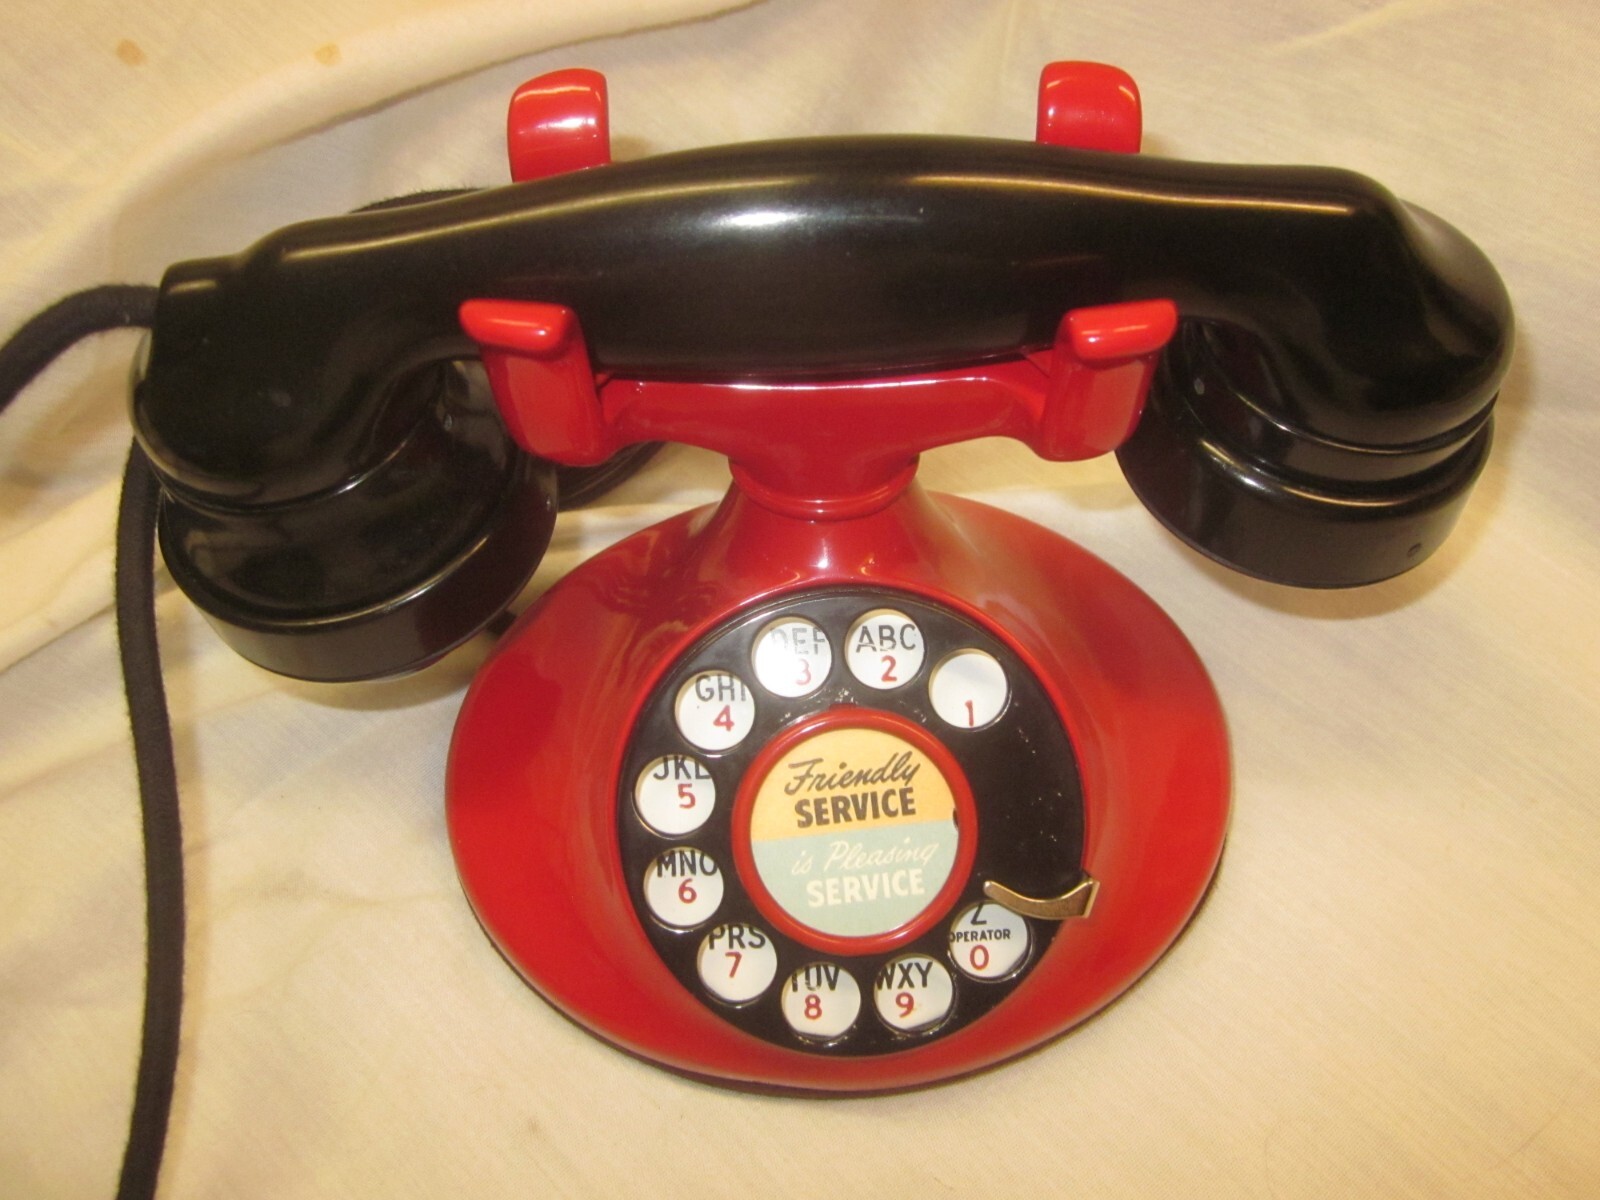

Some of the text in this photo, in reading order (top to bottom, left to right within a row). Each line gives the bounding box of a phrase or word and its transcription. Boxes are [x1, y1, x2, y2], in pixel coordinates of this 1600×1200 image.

[856, 624, 916, 652] ABC
[796, 659, 811, 686] 3
[881, 655, 897, 682] 2
[695, 674, 746, 702] GHI
[713, 705, 734, 732] 4
[965, 700, 974, 726] 1
[653, 756, 712, 780] JKL
[784, 751, 920, 795] Friendly
[678, 783, 696, 809] 5
[795, 787, 916, 828] SERVICE
[657, 850, 718, 877] MNO
[791, 837, 939, 876] is Pleasing
[678, 878, 697, 904] 6
[806, 869, 926, 907] SERVICE
[709, 924, 766, 950] PRS
[949, 929, 1012, 943] OPERATOR
[725, 952, 742, 978] 7
[970, 944, 989, 970] 0
[876, 962, 933, 990] WXY
[804, 994, 822, 1020] 8
[895, 992, 914, 1018] 9
